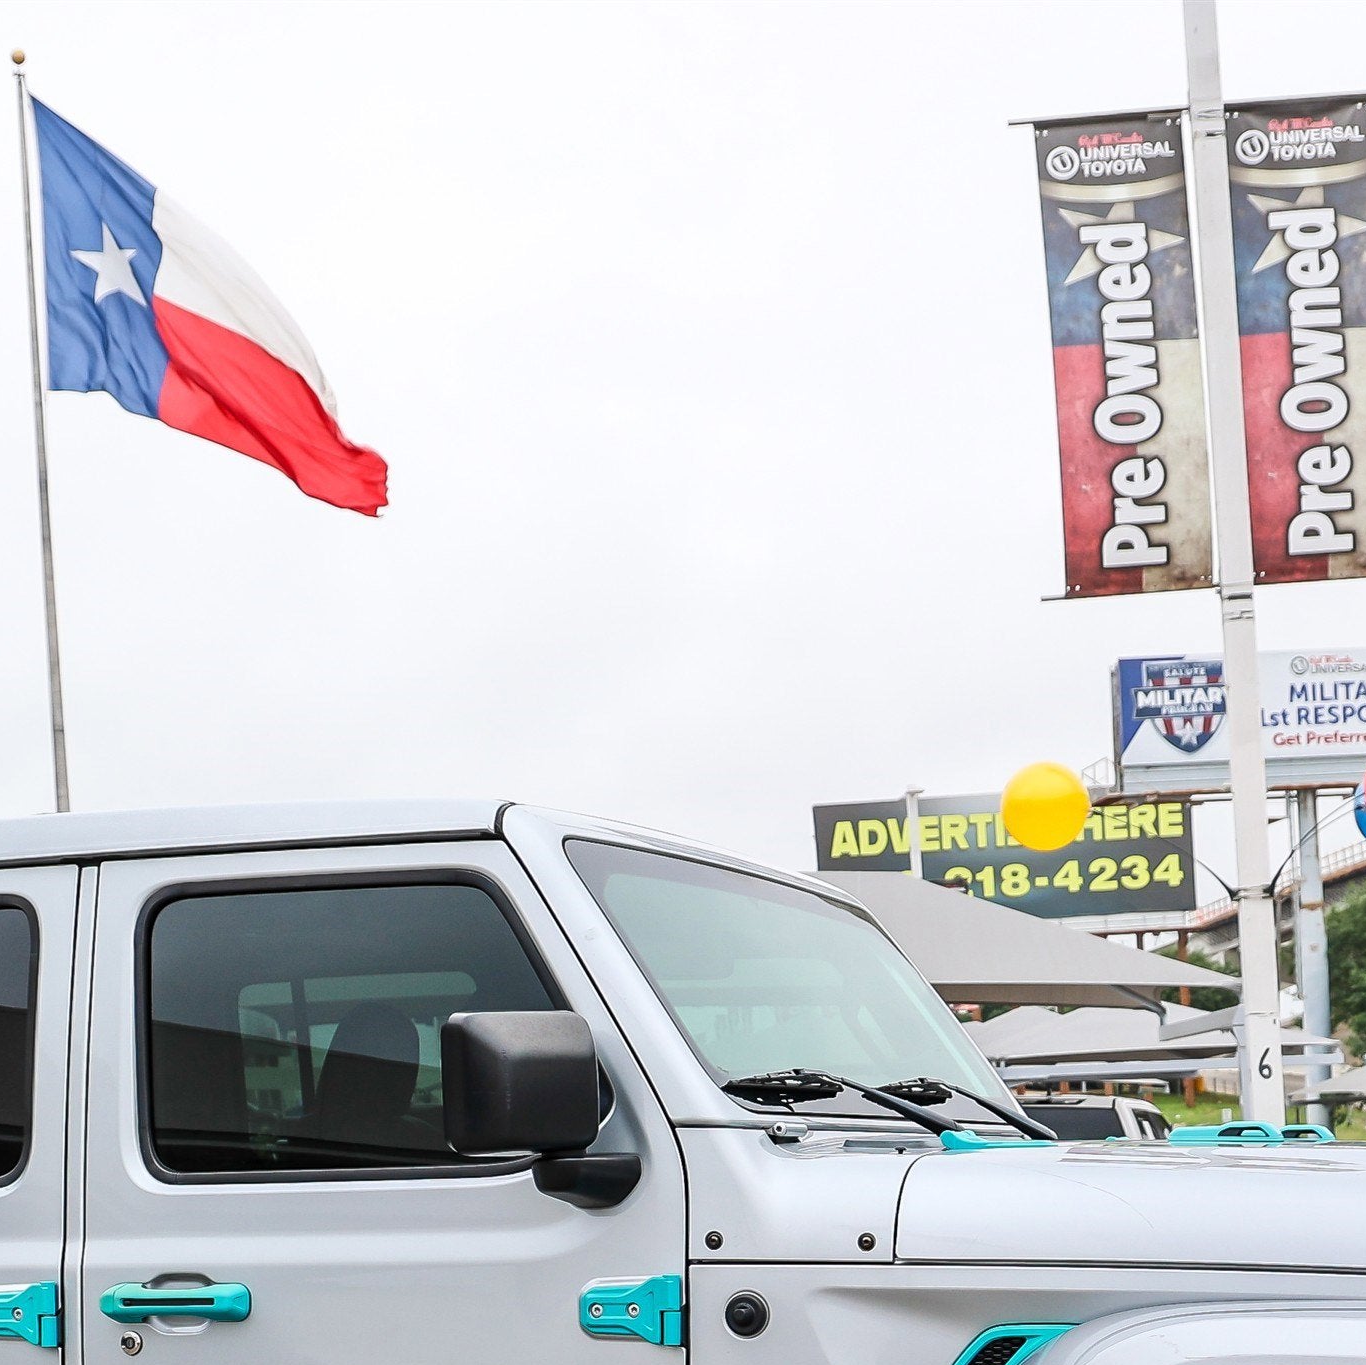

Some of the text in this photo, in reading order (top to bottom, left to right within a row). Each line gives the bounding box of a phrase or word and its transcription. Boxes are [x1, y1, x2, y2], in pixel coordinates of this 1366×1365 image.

[1269, 126, 1365, 145] UNIVERSAL
[1079, 140, 1175, 161] UNIVERSAL
[1270, 142, 1336, 161] TOYOTA
[1080, 158, 1146, 178] TOYOTA
[1080, 221, 1163, 444] Owned
[1268, 206, 1349, 432] Owned
[1102, 456, 1168, 568] Pre
[1288, 445, 1355, 557] Pre
[1136, 686, 1229, 708] MILITAR
[1273, 731, 1302, 746] Get
[830, 811, 1025, 858] ADVERTI
[1258, 1047, 1272, 1079] 6
